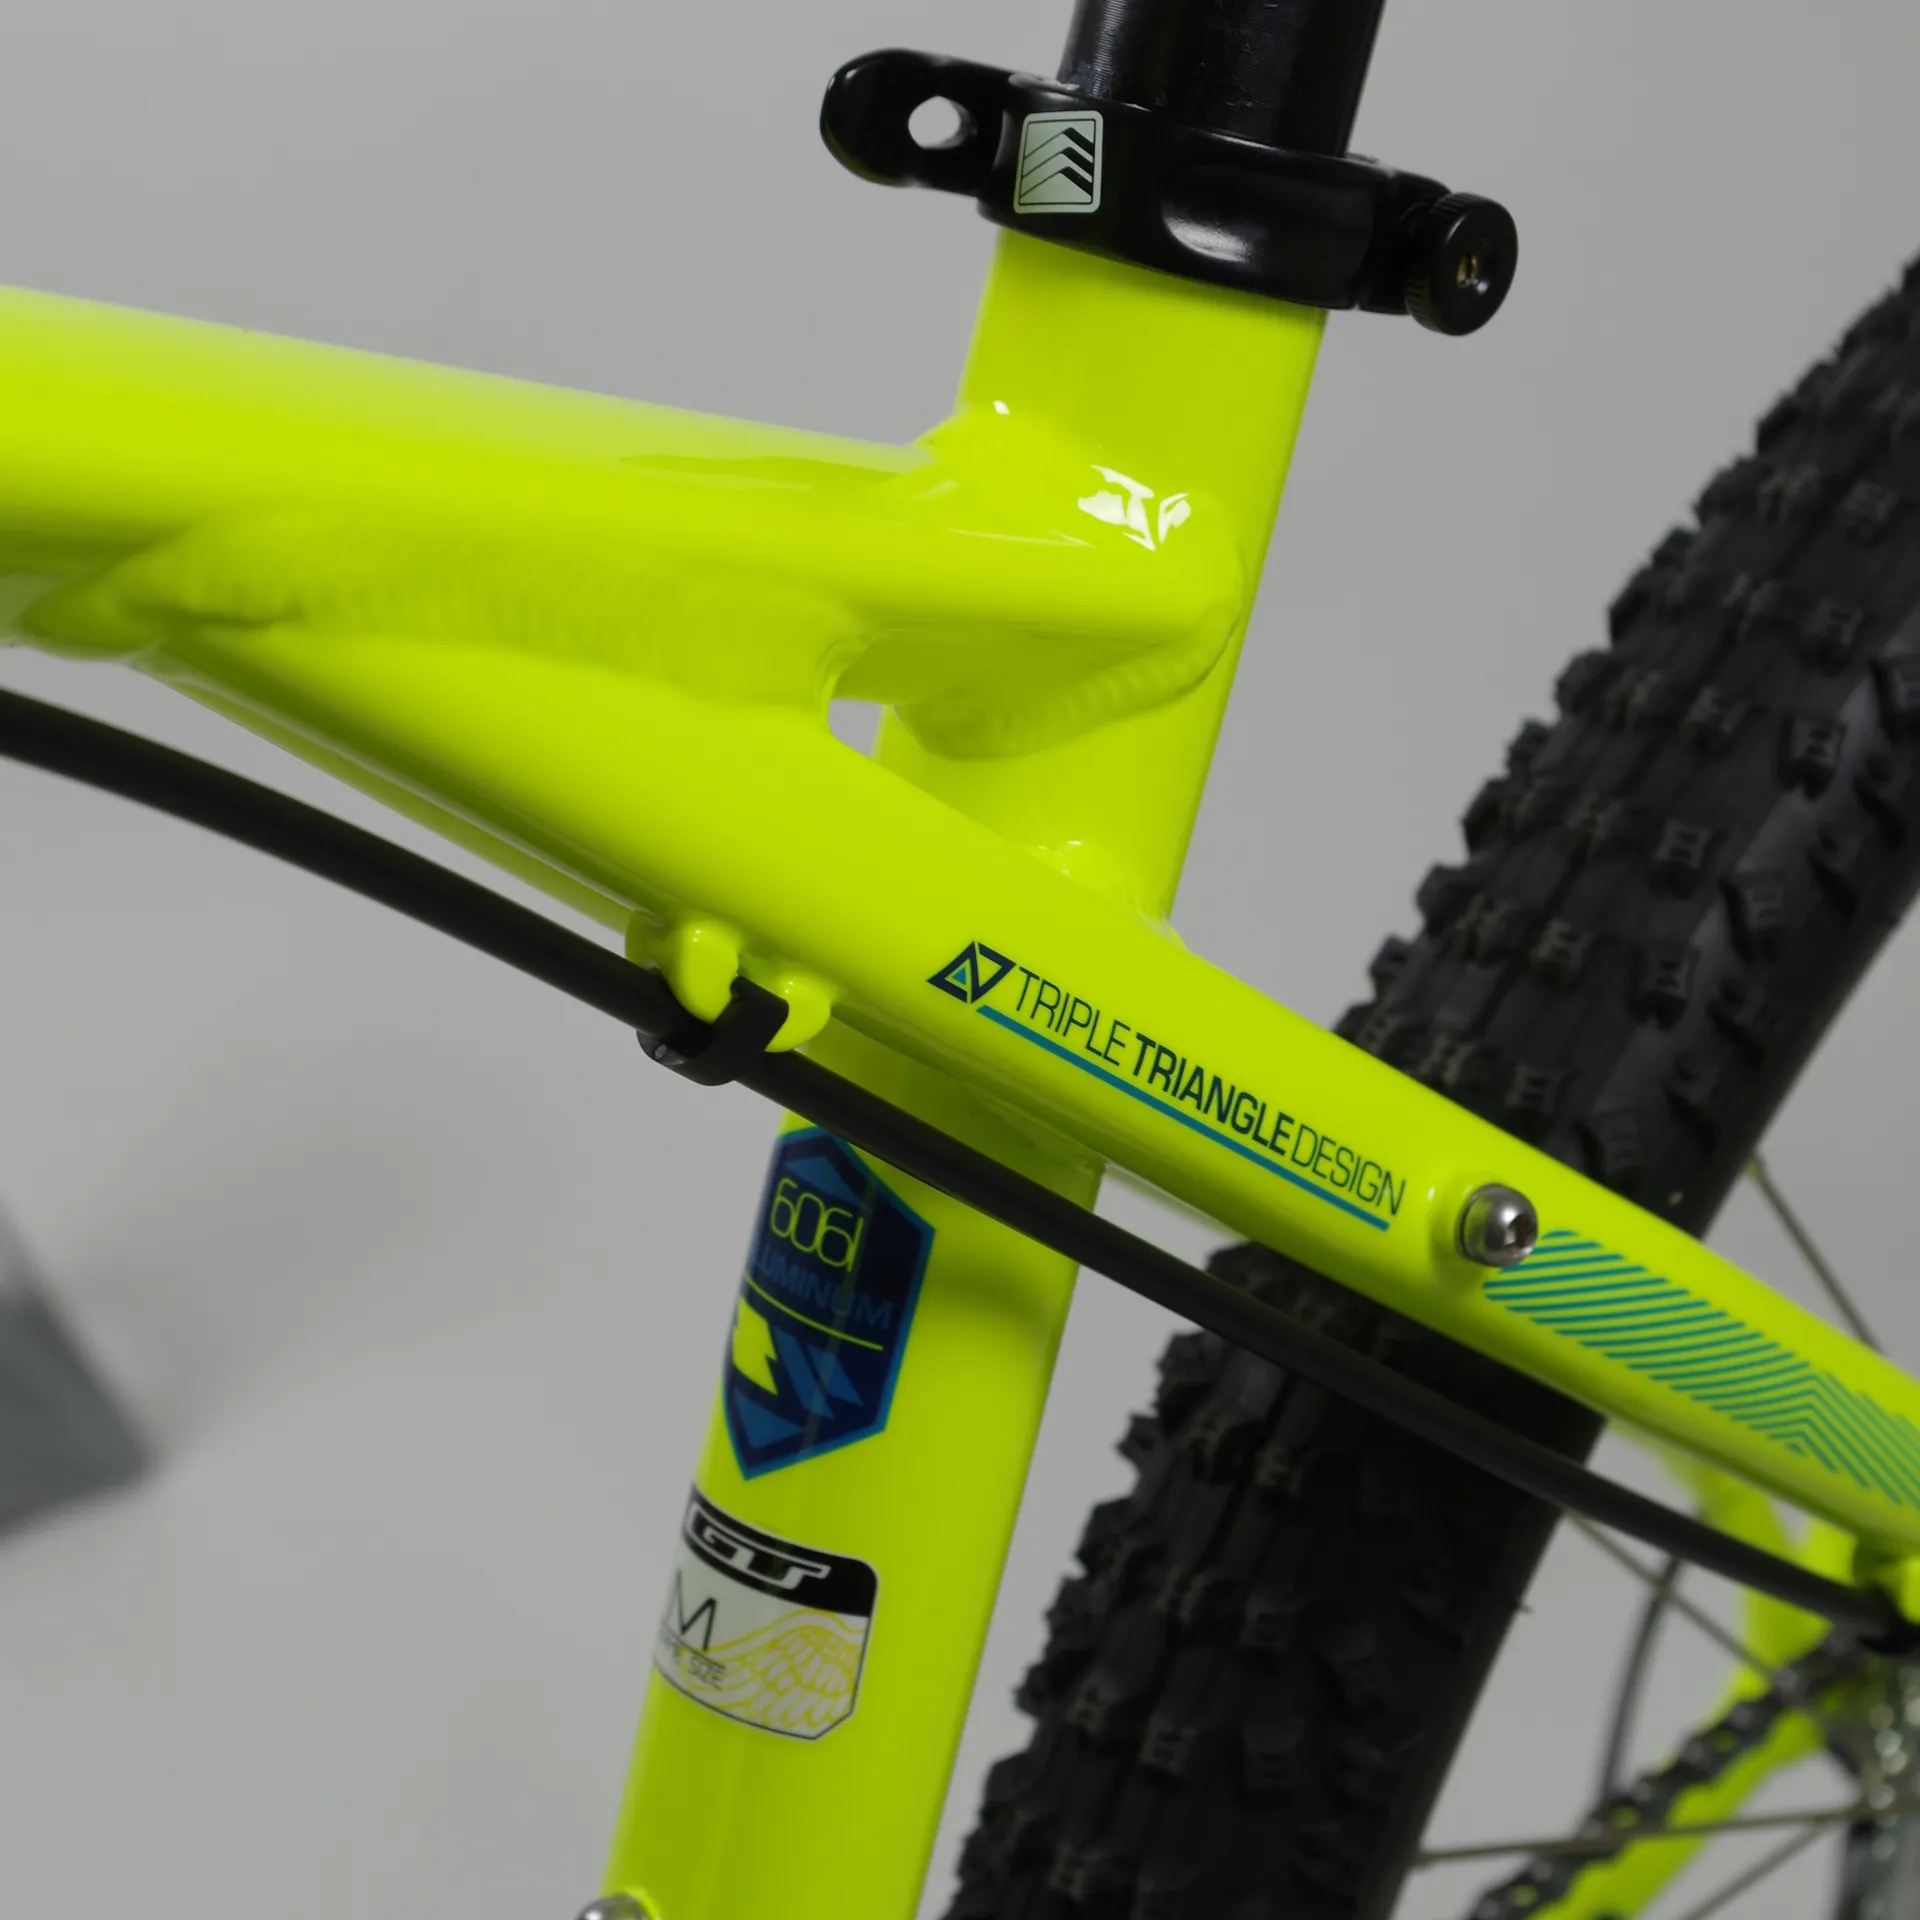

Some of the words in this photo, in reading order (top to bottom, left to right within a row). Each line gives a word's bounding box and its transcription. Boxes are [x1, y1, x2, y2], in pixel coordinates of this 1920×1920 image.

[1016, 966, 1131, 1067] TRIPLE
[1132, 1032, 1296, 1156] TRIANGLE
[1290, 1124, 1407, 1217] DESIGN
[769, 1177, 865, 1273] 6061
[683, 1500, 832, 1591] GT
[665, 1567, 718, 1653] M
[688, 1656, 727, 1692] SIZE
